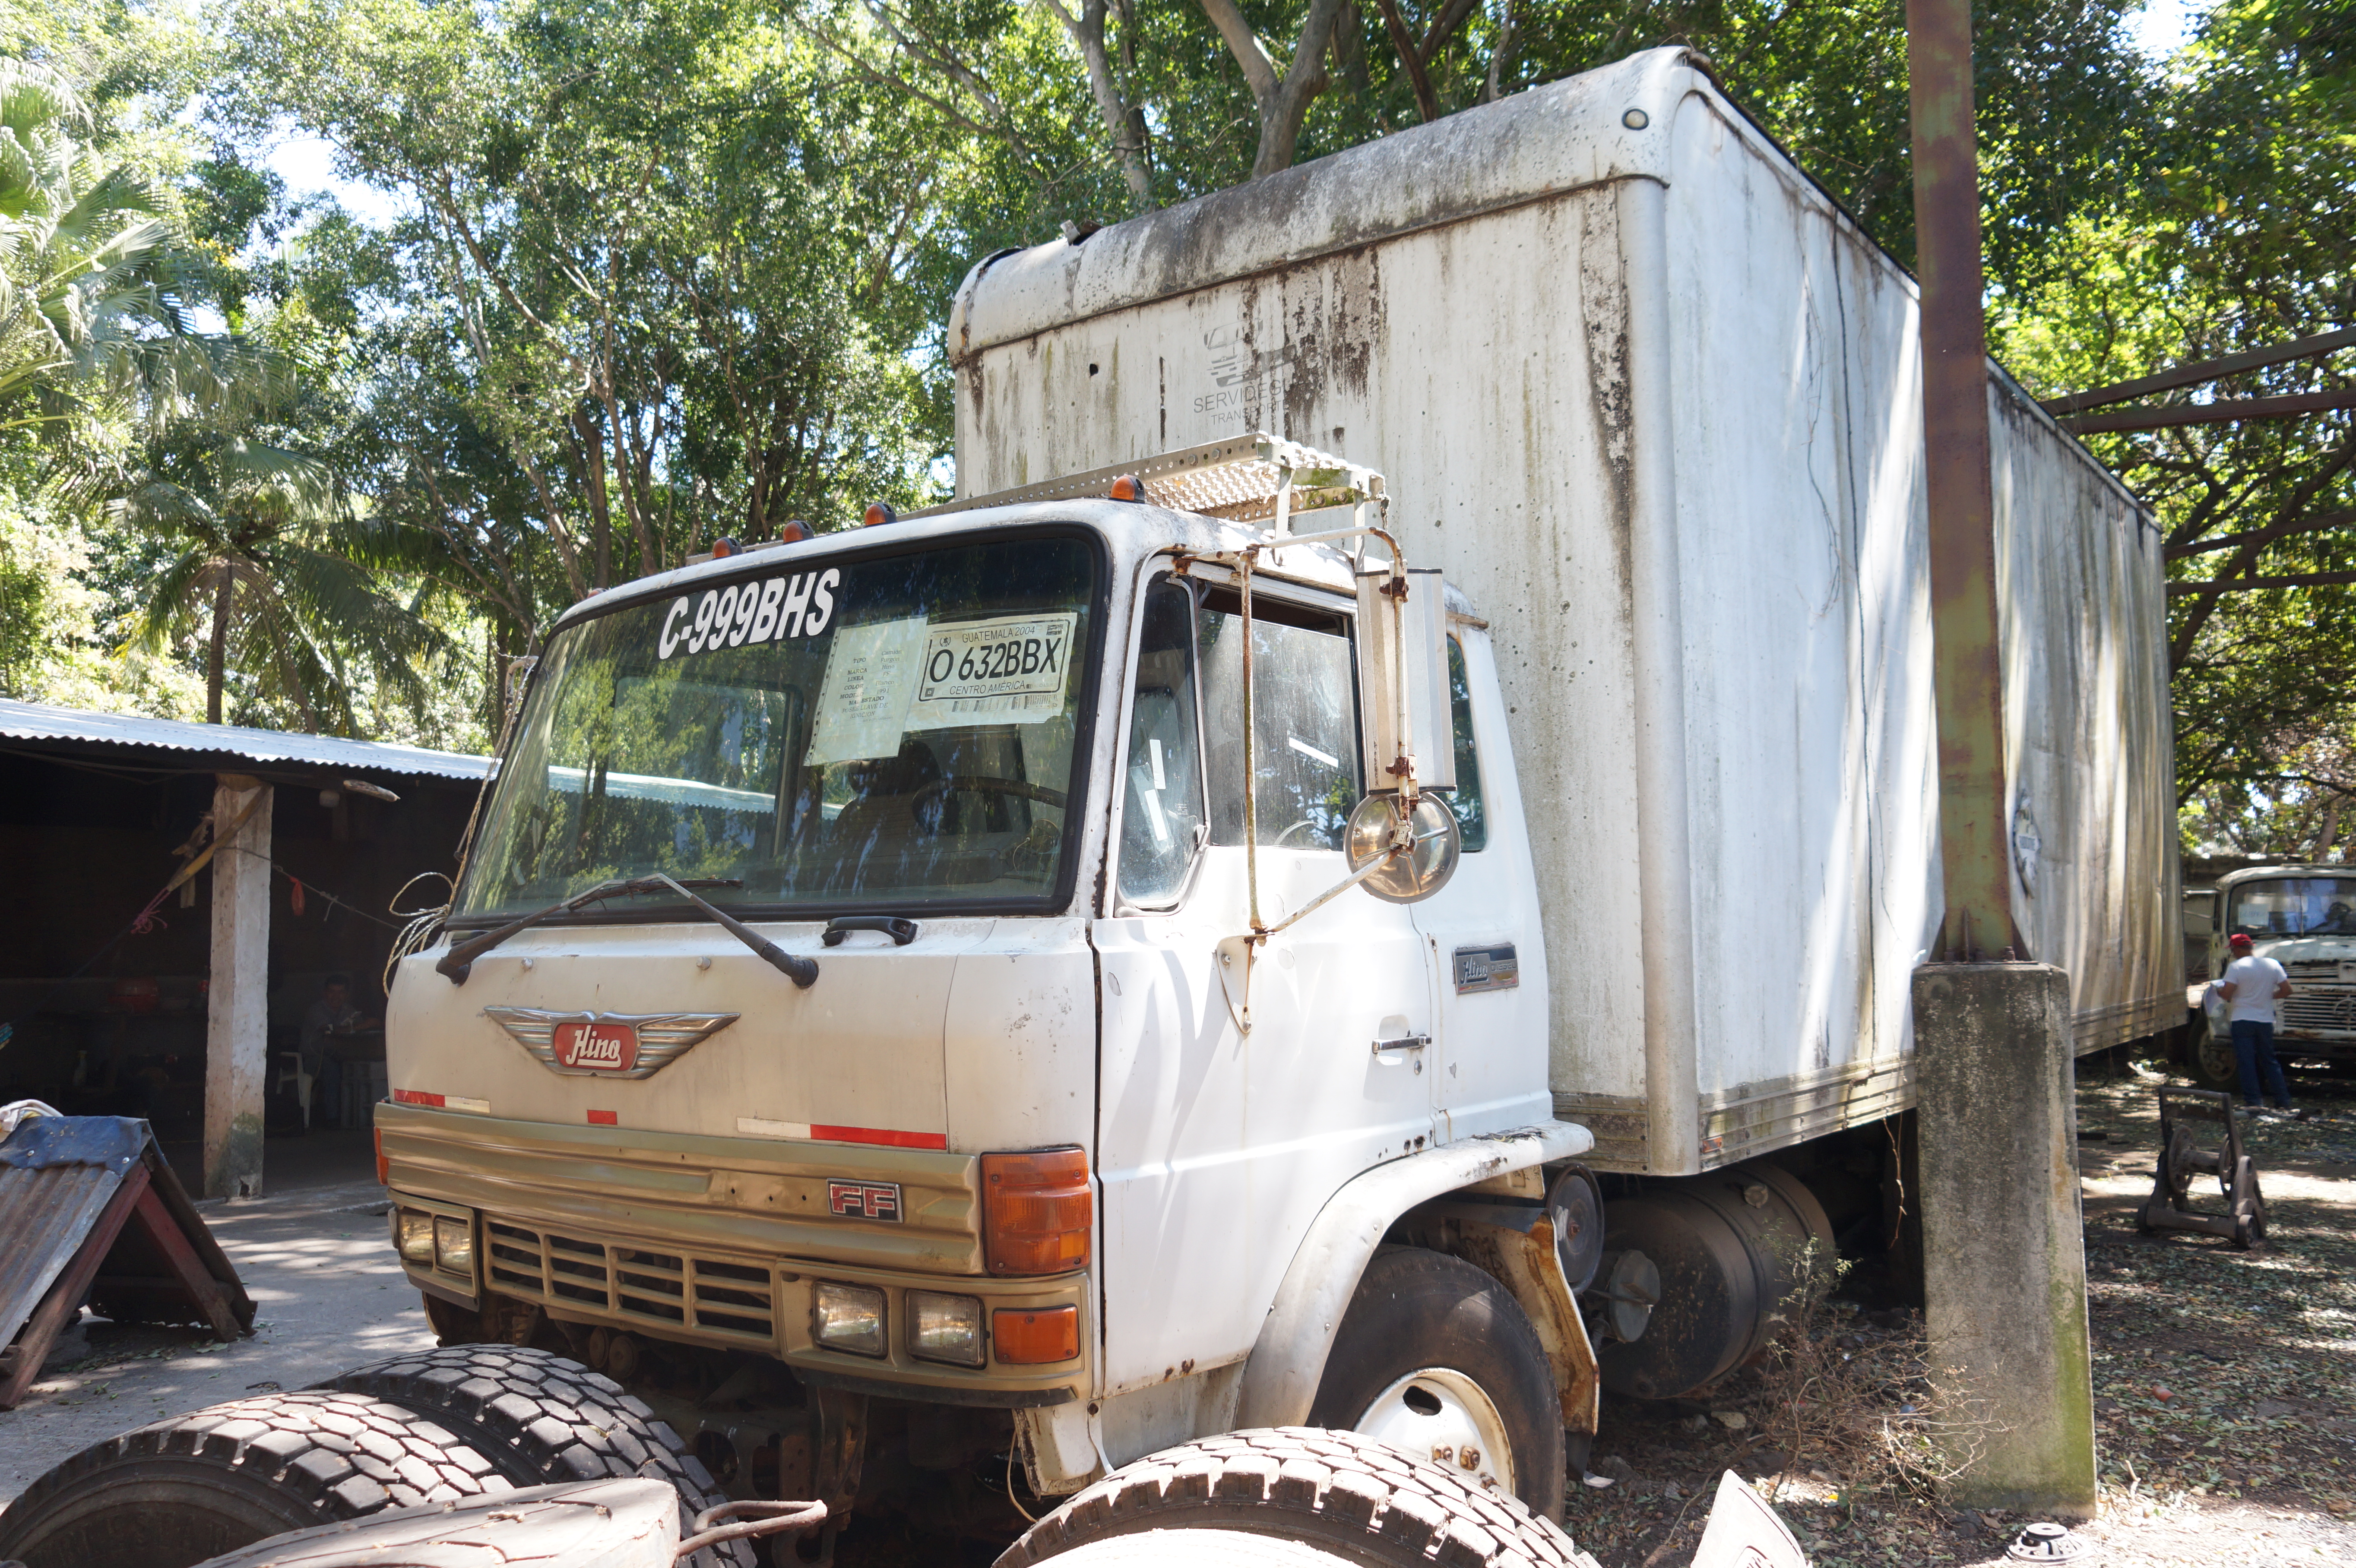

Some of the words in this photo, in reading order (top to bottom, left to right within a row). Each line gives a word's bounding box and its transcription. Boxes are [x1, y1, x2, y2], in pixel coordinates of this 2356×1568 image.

[659, 568, 840, 660] C-999BHS
[963, 628, 1013, 643] GUATEMALA
[1015, 626, 1036, 635] 2004
[958, 638, 1061, 681] 632BBX
[950, 684, 987, 695] CENTRO
[988, 680, 1025, 693] AMÉRICA
[1460, 956, 1488, 984] Hino
[1491, 961, 1516, 971] DIESEL
[566, 1024, 622, 1068] Hino
[830, 1183, 895, 1217] FF
